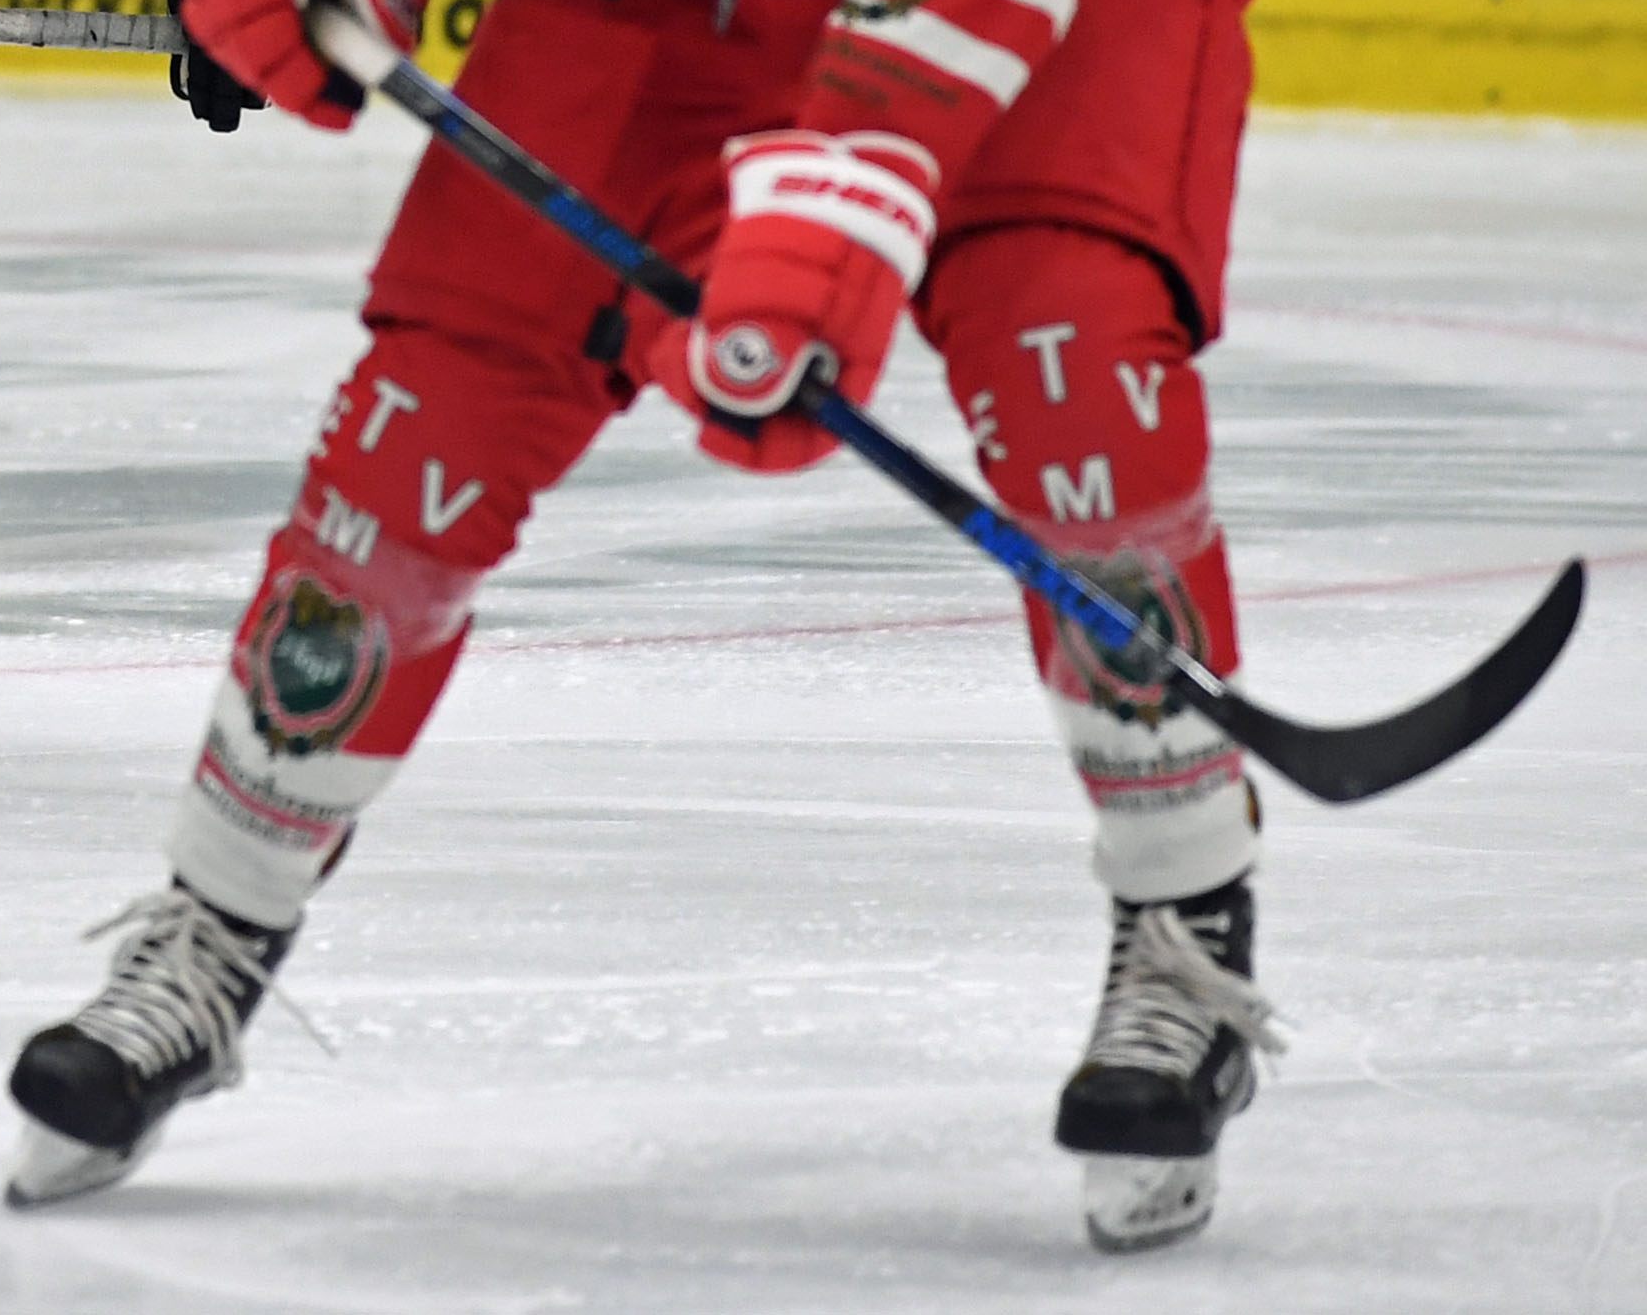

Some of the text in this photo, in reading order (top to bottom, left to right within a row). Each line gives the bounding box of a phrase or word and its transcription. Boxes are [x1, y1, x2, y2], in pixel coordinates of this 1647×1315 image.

[1017, 322, 1077, 405] T
[1115, 360, 1165, 431] V
[358, 376, 420, 453] T
[418, 457, 485, 535] V
[1040, 453, 1117, 523] M
